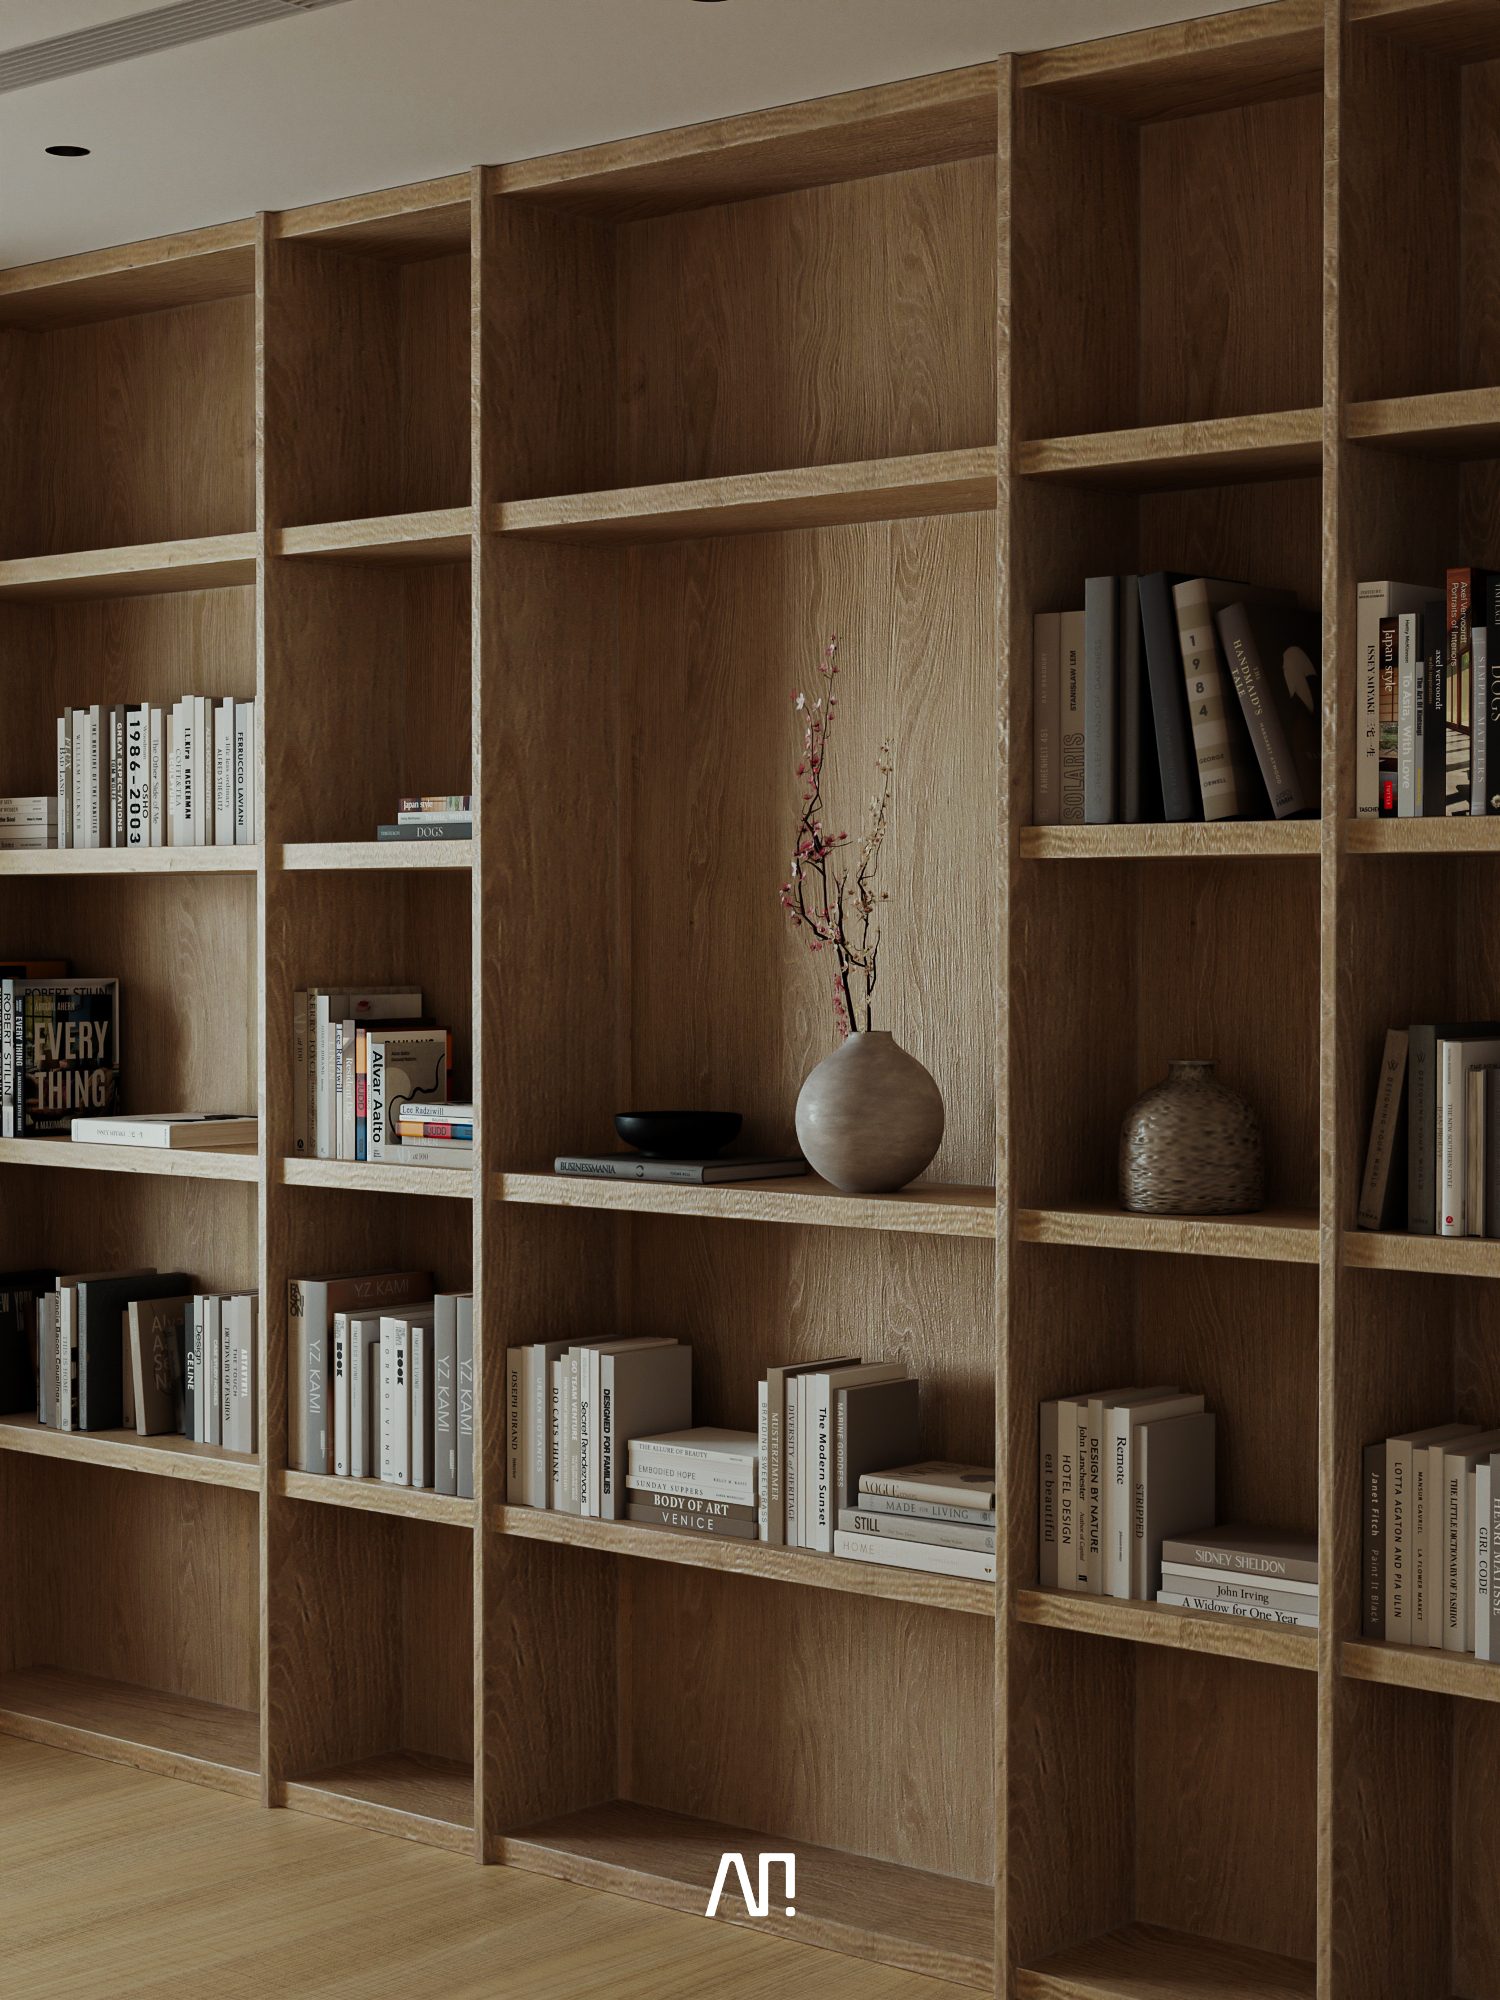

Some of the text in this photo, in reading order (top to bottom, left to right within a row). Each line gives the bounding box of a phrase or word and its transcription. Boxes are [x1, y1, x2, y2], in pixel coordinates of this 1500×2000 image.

[1460, 581, 1468, 601] Axel
[1450, 582, 1459, 666] Portraits of Interiors
[1367, 645, 1375, 674] ISSEY
[1381, 629, 1396, 692] Japan style
[1435, 648, 1443, 710] axel vervoordt
[1400, 672, 1413, 789] To Asia, With Love
[1477, 656, 1485, 783] SIMPLE MATTERS
[1063, 733, 1084, 819] SOLARIS
[403, 801, 419, 811] Japan
[416, 827, 444, 837] DOGS
[33, 1020, 109, 1061] EVERY
[35, 1070, 106, 1110] THING
[372, 1050, 383, 1143] Alvar Aalto
[402, 1105, 444, 1116] Lee Radziwill
[428, 1127, 447, 1136] JUDD
[560, 1162, 617, 1175] BUSINESSMANIA
[195, 1325, 203, 1365] Design
[224, 1375, 230, 1386] OF
[309, 1339, 321, 1413] Y.Z. KAMI
[570, 1360, 578, 1374] GO
[437, 1355, 450, 1432] Y.Z. KAMI
[460, 1358, 472, 1435] Y.Z. KAMI
[552, 1387, 559, 1403] DO
[581, 1401, 589, 1504] Secret Rendezvous
[603, 1388, 611, 1494] DESIGNED FOR FAMILIES
[652, 1444, 674, 1455] ALLURE
[684, 1449, 708, 1459] BEAUTY
[1077, 1425, 1088, 1447] John
[552, 1441, 560, 1483] THINK?
[638, 1464, 696, 1480] EMBODIED HOPE
[771, 1412, 779, 1501] MUSTERZIMMER
[788, 1460, 794, 1470] of
[819, 1407, 827, 1526] The Modern Sunset
[1079, 1450, 1087, 1501] Lanchester
[1116, 1437, 1127, 1485] Remote
[636, 1480, 704, 1496] SUNDAY SUPPERS
[654, 1494, 729, 1516] BODY OF ART
[1044, 1454, 1055, 1543] eat beautiful
[1062, 1455, 1072, 1545] HOTEL DESIGN
[1090, 1438, 1099, 1554] DESIGN BY NATURE
[662, 1511, 715, 1531] VENICE
[854, 1515, 880, 1532] STILL
[886, 1501, 916, 1513] MADE
[932, 1506, 969, 1520] LIVING
[1135, 1483, 1144, 1539] STRIPPED
[843, 1542, 875, 1555] HOME
[1079, 1533, 1086, 1541] of
[1370, 1472, 1380, 1624] Janet Fitch Paint It Black
[1393, 1462, 1403, 1618] LOTTA AGATON AND PIA ULIN
[1417, 1548, 1423, 1558] LA
[1450, 1478, 1458, 1629] THE LITTLE DICTIONARY OF FASHION
[1195, 1549, 1286, 1574] SIDNEY SHELDON
[1478, 1527, 1488, 1595] GIRL CODE
[1216, 1585, 1269, 1605] John Irving
[1492, 1552, 1500, 1616] MATISSE
[1182, 1597, 1299, 1625] A Widow for One Year
